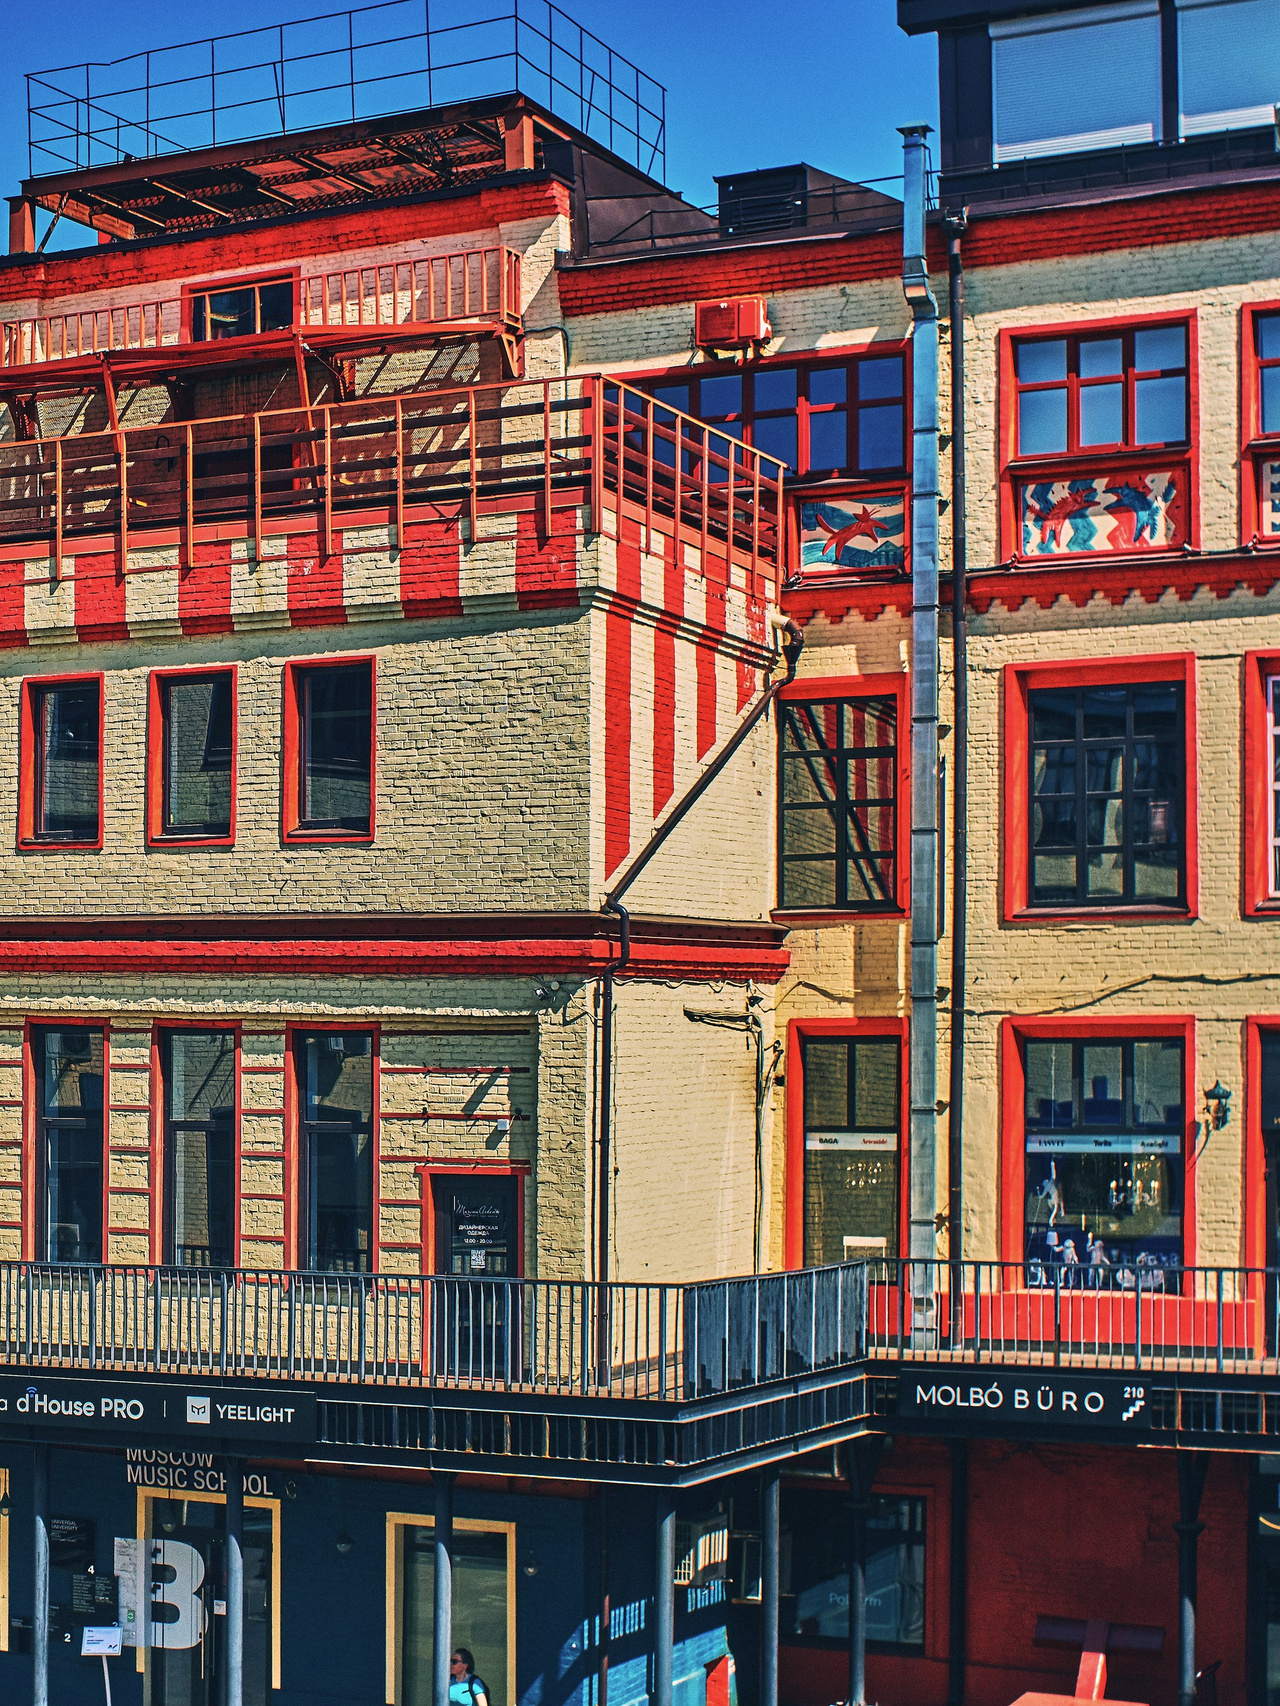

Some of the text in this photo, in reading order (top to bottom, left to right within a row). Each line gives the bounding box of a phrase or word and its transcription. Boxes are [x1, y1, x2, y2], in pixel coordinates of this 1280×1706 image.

[916, 1382, 1004, 1408] MOLBÓ
[1123, 1386, 1145, 1399] 210
[101, 1398, 144, 1420] PRO
[215, 1403, 295, 1423] YEELIGHT
[126, 1448, 213, 1468] MOSCOW
[126, 1464, 188, 1488] MUSIC
[87, 1564, 95, 1575] 4
[64, 1632, 71, 1642] 2
